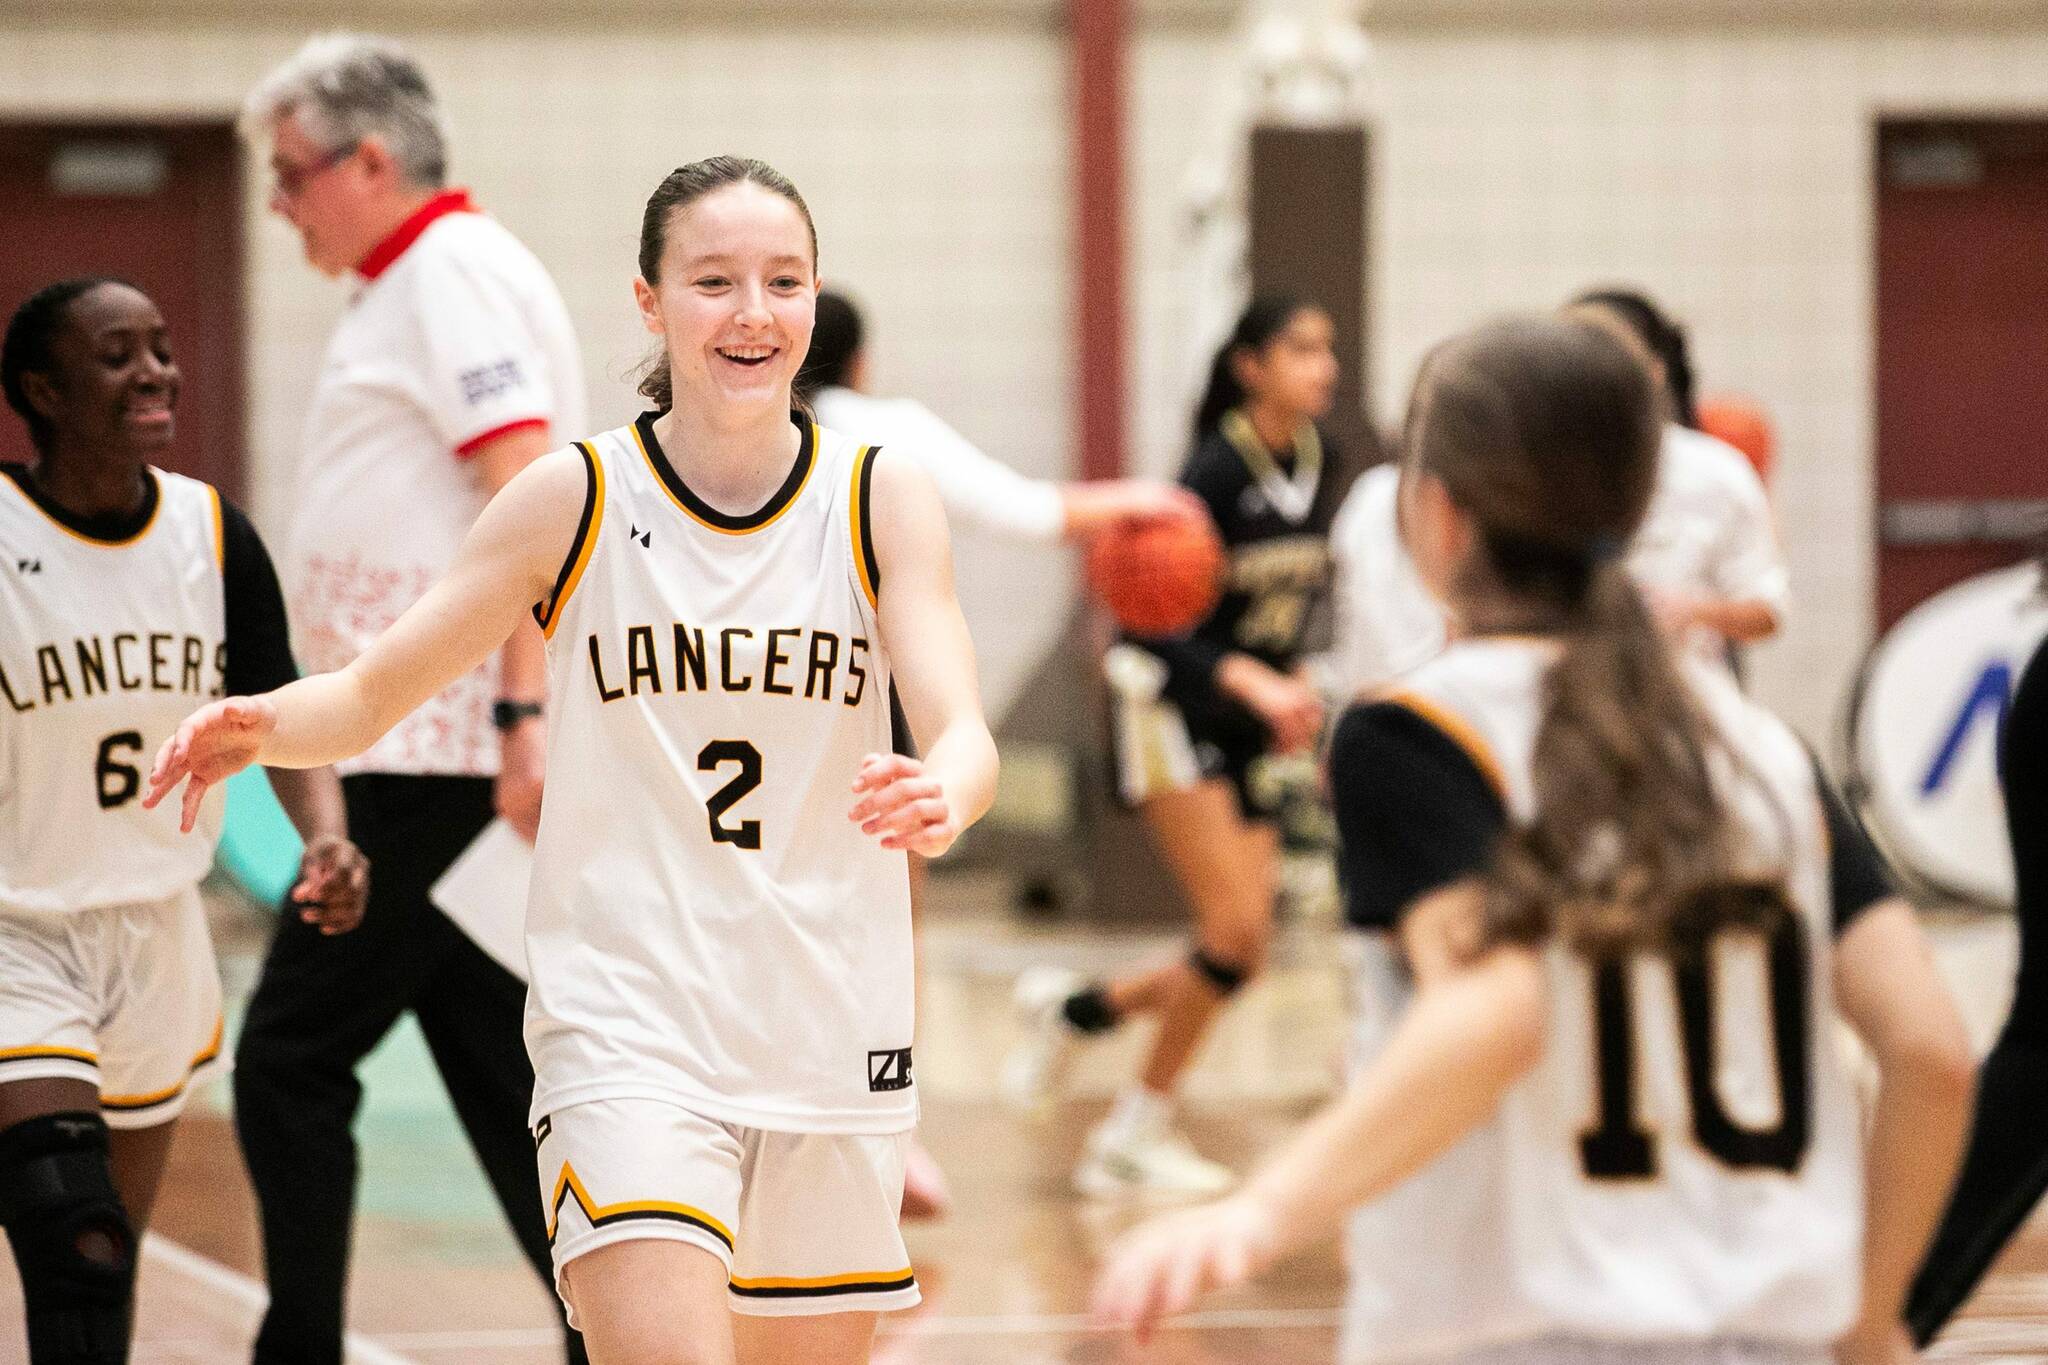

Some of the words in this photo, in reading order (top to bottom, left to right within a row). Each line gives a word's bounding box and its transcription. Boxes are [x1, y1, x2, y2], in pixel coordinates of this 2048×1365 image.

[588, 623, 870, 708] LANCERS
[96, 730, 144, 810] 6
[696, 740, 763, 851] 2
[1577, 877, 1812, 1182] 10
